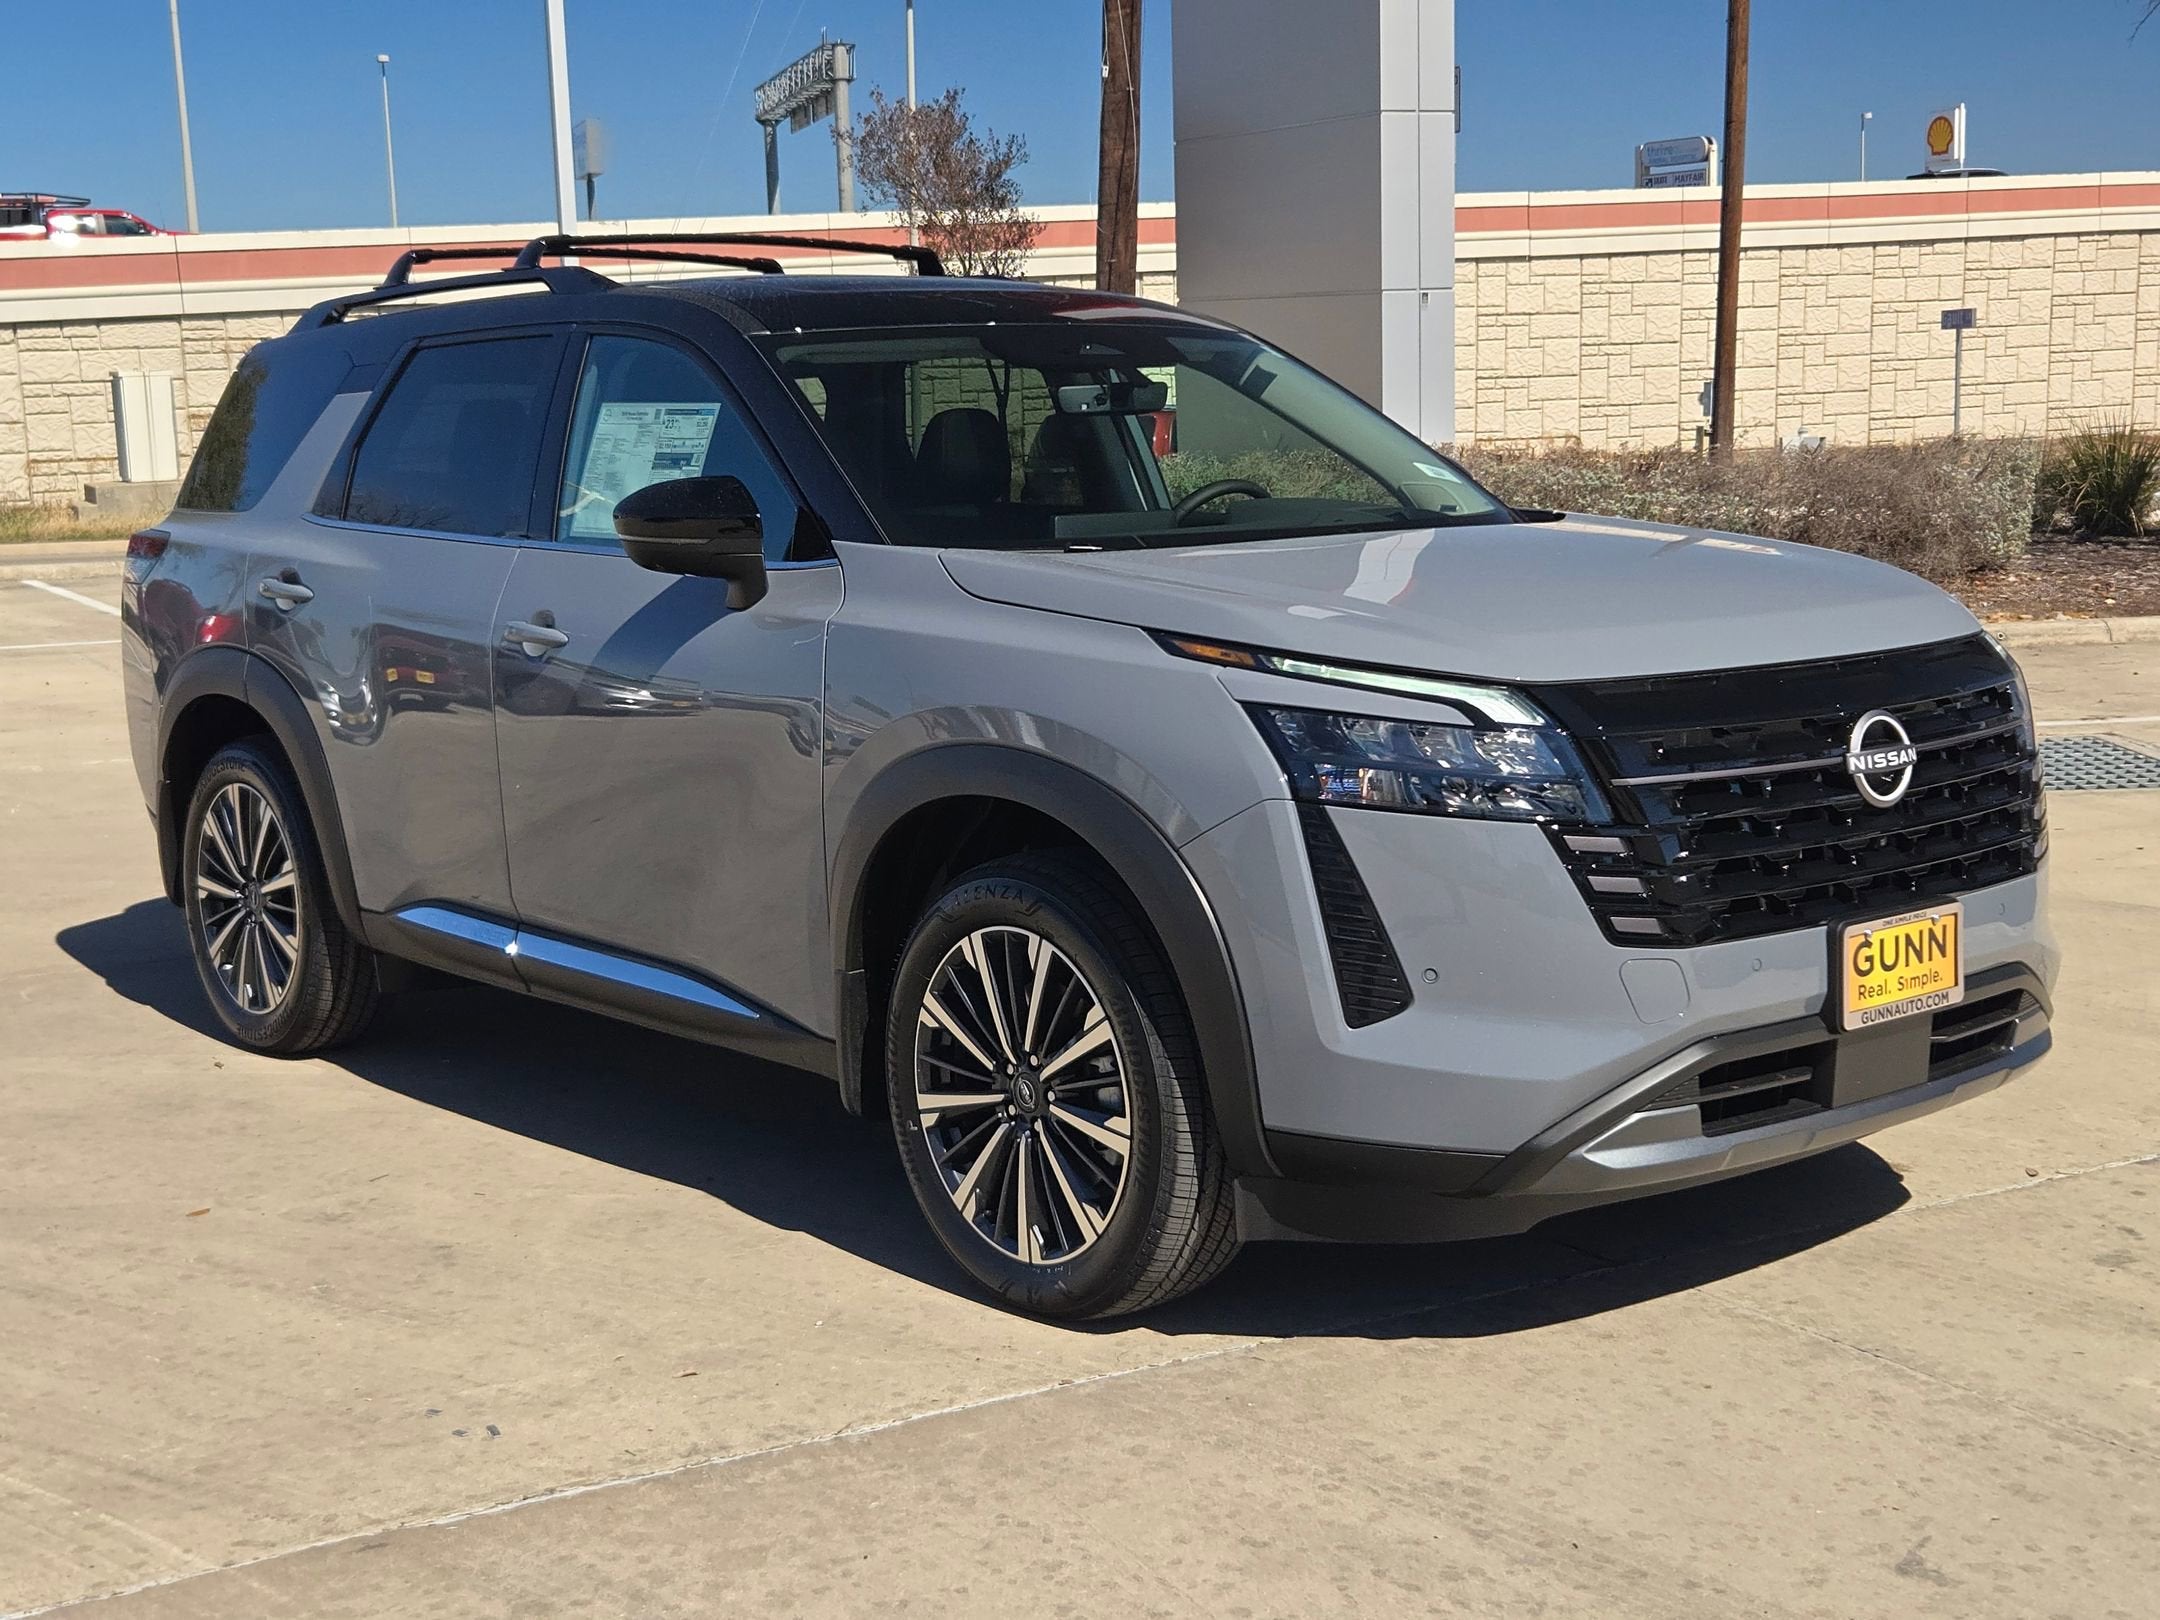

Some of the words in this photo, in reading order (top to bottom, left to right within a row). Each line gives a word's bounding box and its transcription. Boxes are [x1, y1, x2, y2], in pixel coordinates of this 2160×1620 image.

[1674, 172, 1705, 184] MAYFAIR
[665, 419, 675, 430] 23
[1849, 747, 1917, 771] NISSAN
[1852, 924, 1948, 978] GUNN
[1858, 979, 1892, 1001] Real.
[1897, 968, 1943, 991] Simple.
[1861, 991, 1950, 1025] GUNNAUTO.COM
